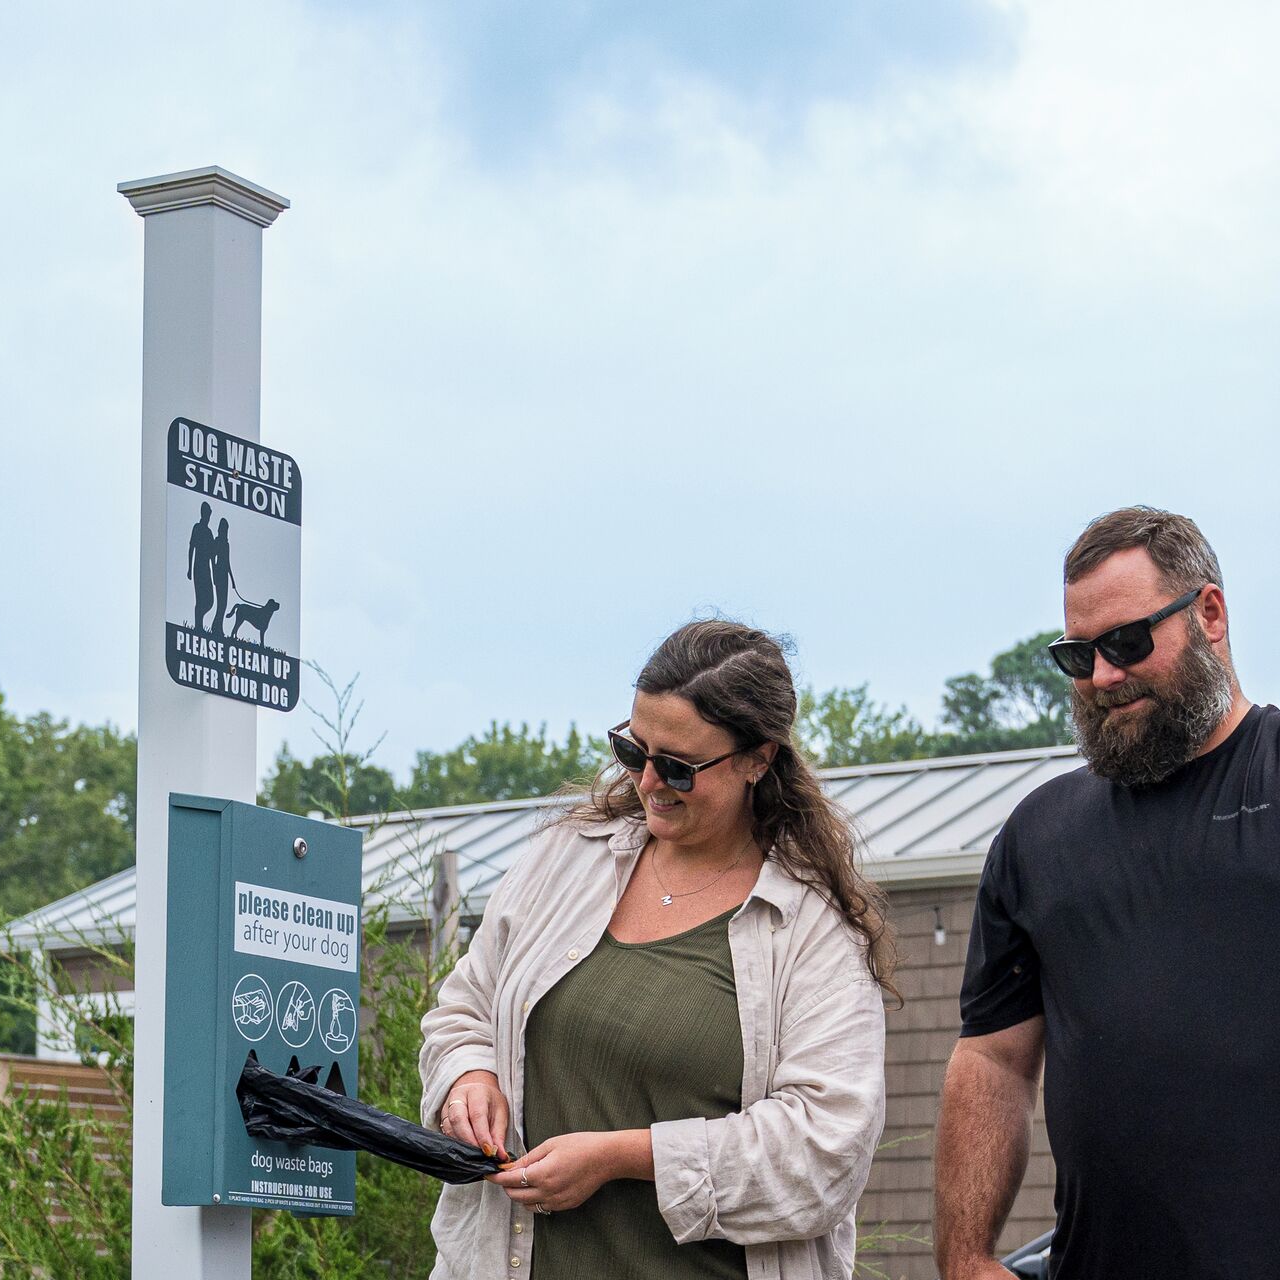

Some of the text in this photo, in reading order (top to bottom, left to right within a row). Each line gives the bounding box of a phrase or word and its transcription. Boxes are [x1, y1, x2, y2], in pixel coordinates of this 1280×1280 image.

[178, 422, 292, 489] DOG WASTE
[185, 462, 286, 518] STATION
[176, 630, 291, 681] PLEASE CLEAN UP
[179, 660, 289, 708] AFTER YOUR DOG
[238, 890, 355, 936] please clean up
[243, 920, 349, 964] after your dog
[251, 1149, 333, 1178] dog waste bags
[251, 1180, 333, 1199] INSTRUCTIONS FOR USE
